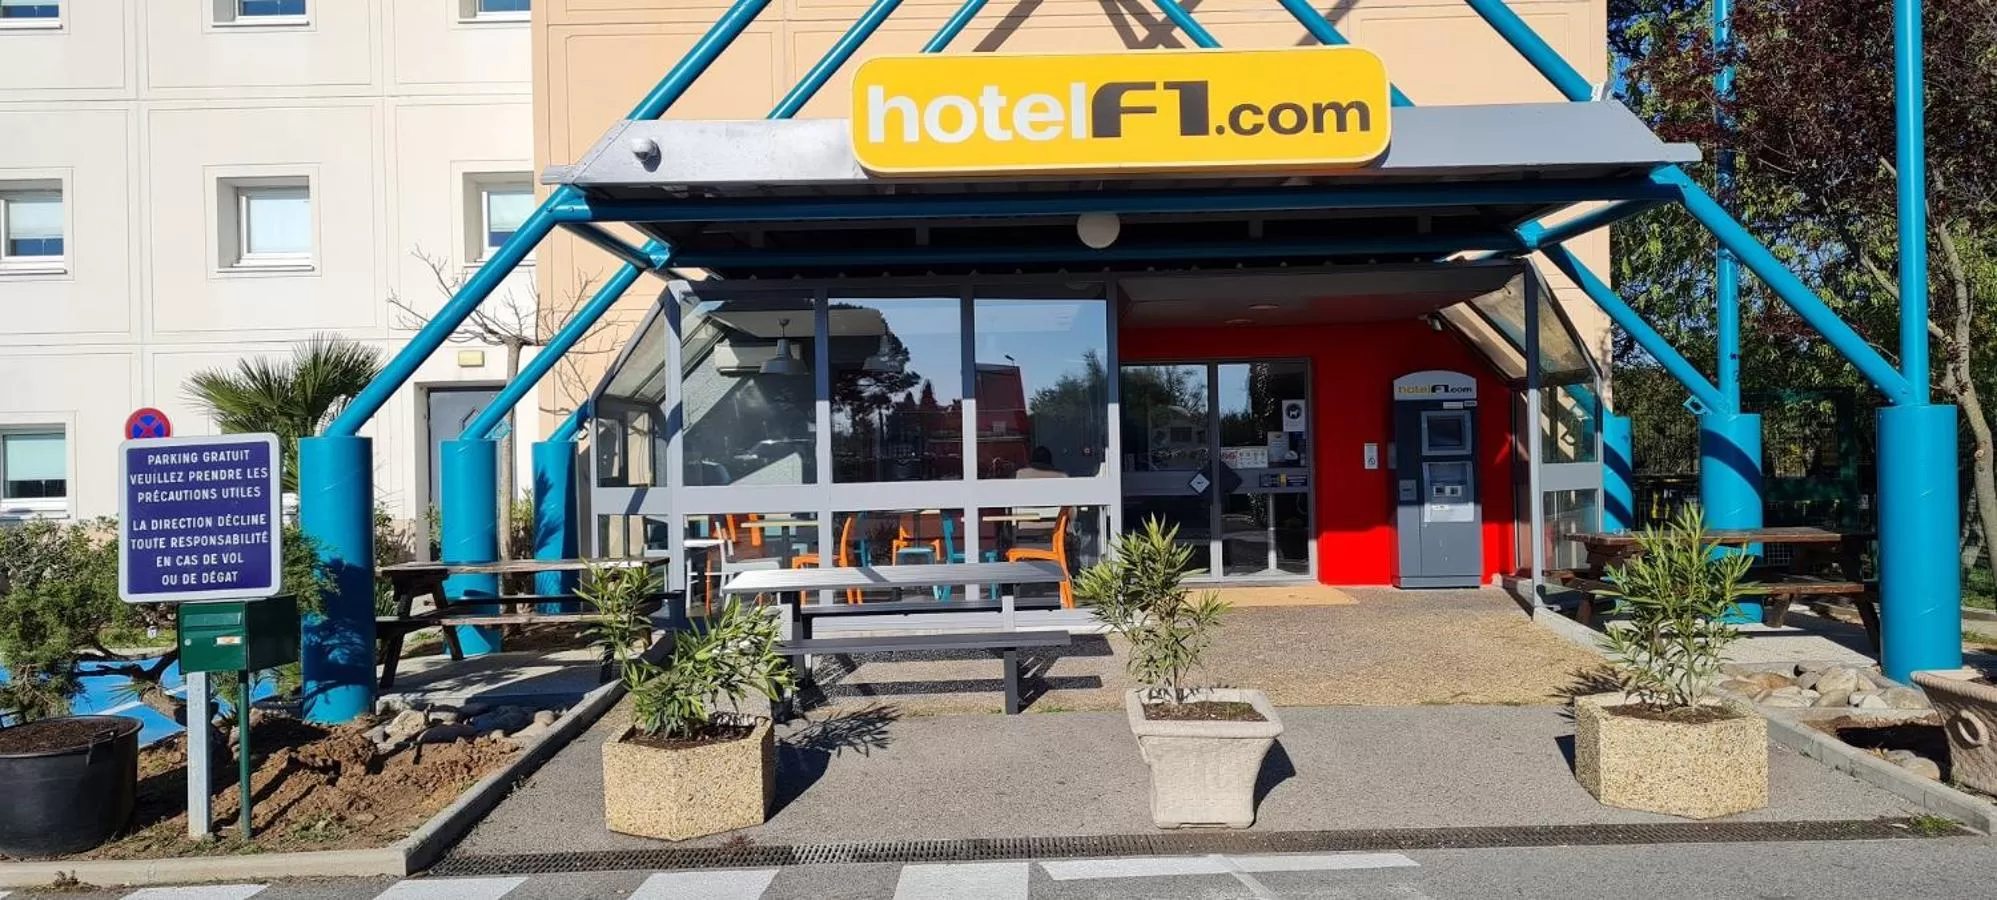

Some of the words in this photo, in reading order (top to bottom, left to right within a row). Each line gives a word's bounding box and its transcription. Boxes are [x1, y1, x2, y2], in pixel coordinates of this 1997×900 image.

[867, 80, 1371, 144] hotelF1.com
[148, 452, 198, 465] PARKING
[203, 450, 250, 463] GRATUIT
[130, 471, 184, 485] VEUILLEZ
[189, 468, 242, 482] PRENDRE
[247, 467, 268, 479] LES
[138, 488, 217, 503] PRÉCAUTIONS
[222, 486, 261, 499] UTILES
[133, 520, 147, 531] LA
[152, 517, 212, 531] DIRECTION
[218, 514, 267, 527] DÉCLINE
[131, 537, 166, 550] TOUTE
[171, 531, 268, 548] RESPONSABILITÉ
[157, 556, 171, 567] EN
[176, 554, 198, 566] CAS
[203, 553, 217, 565] DE
[222, 552, 244, 564] VOL
[162, 574, 177, 585] OU
[183, 573, 196, 584] DE
[202, 571, 238, 583] DÉGAT
